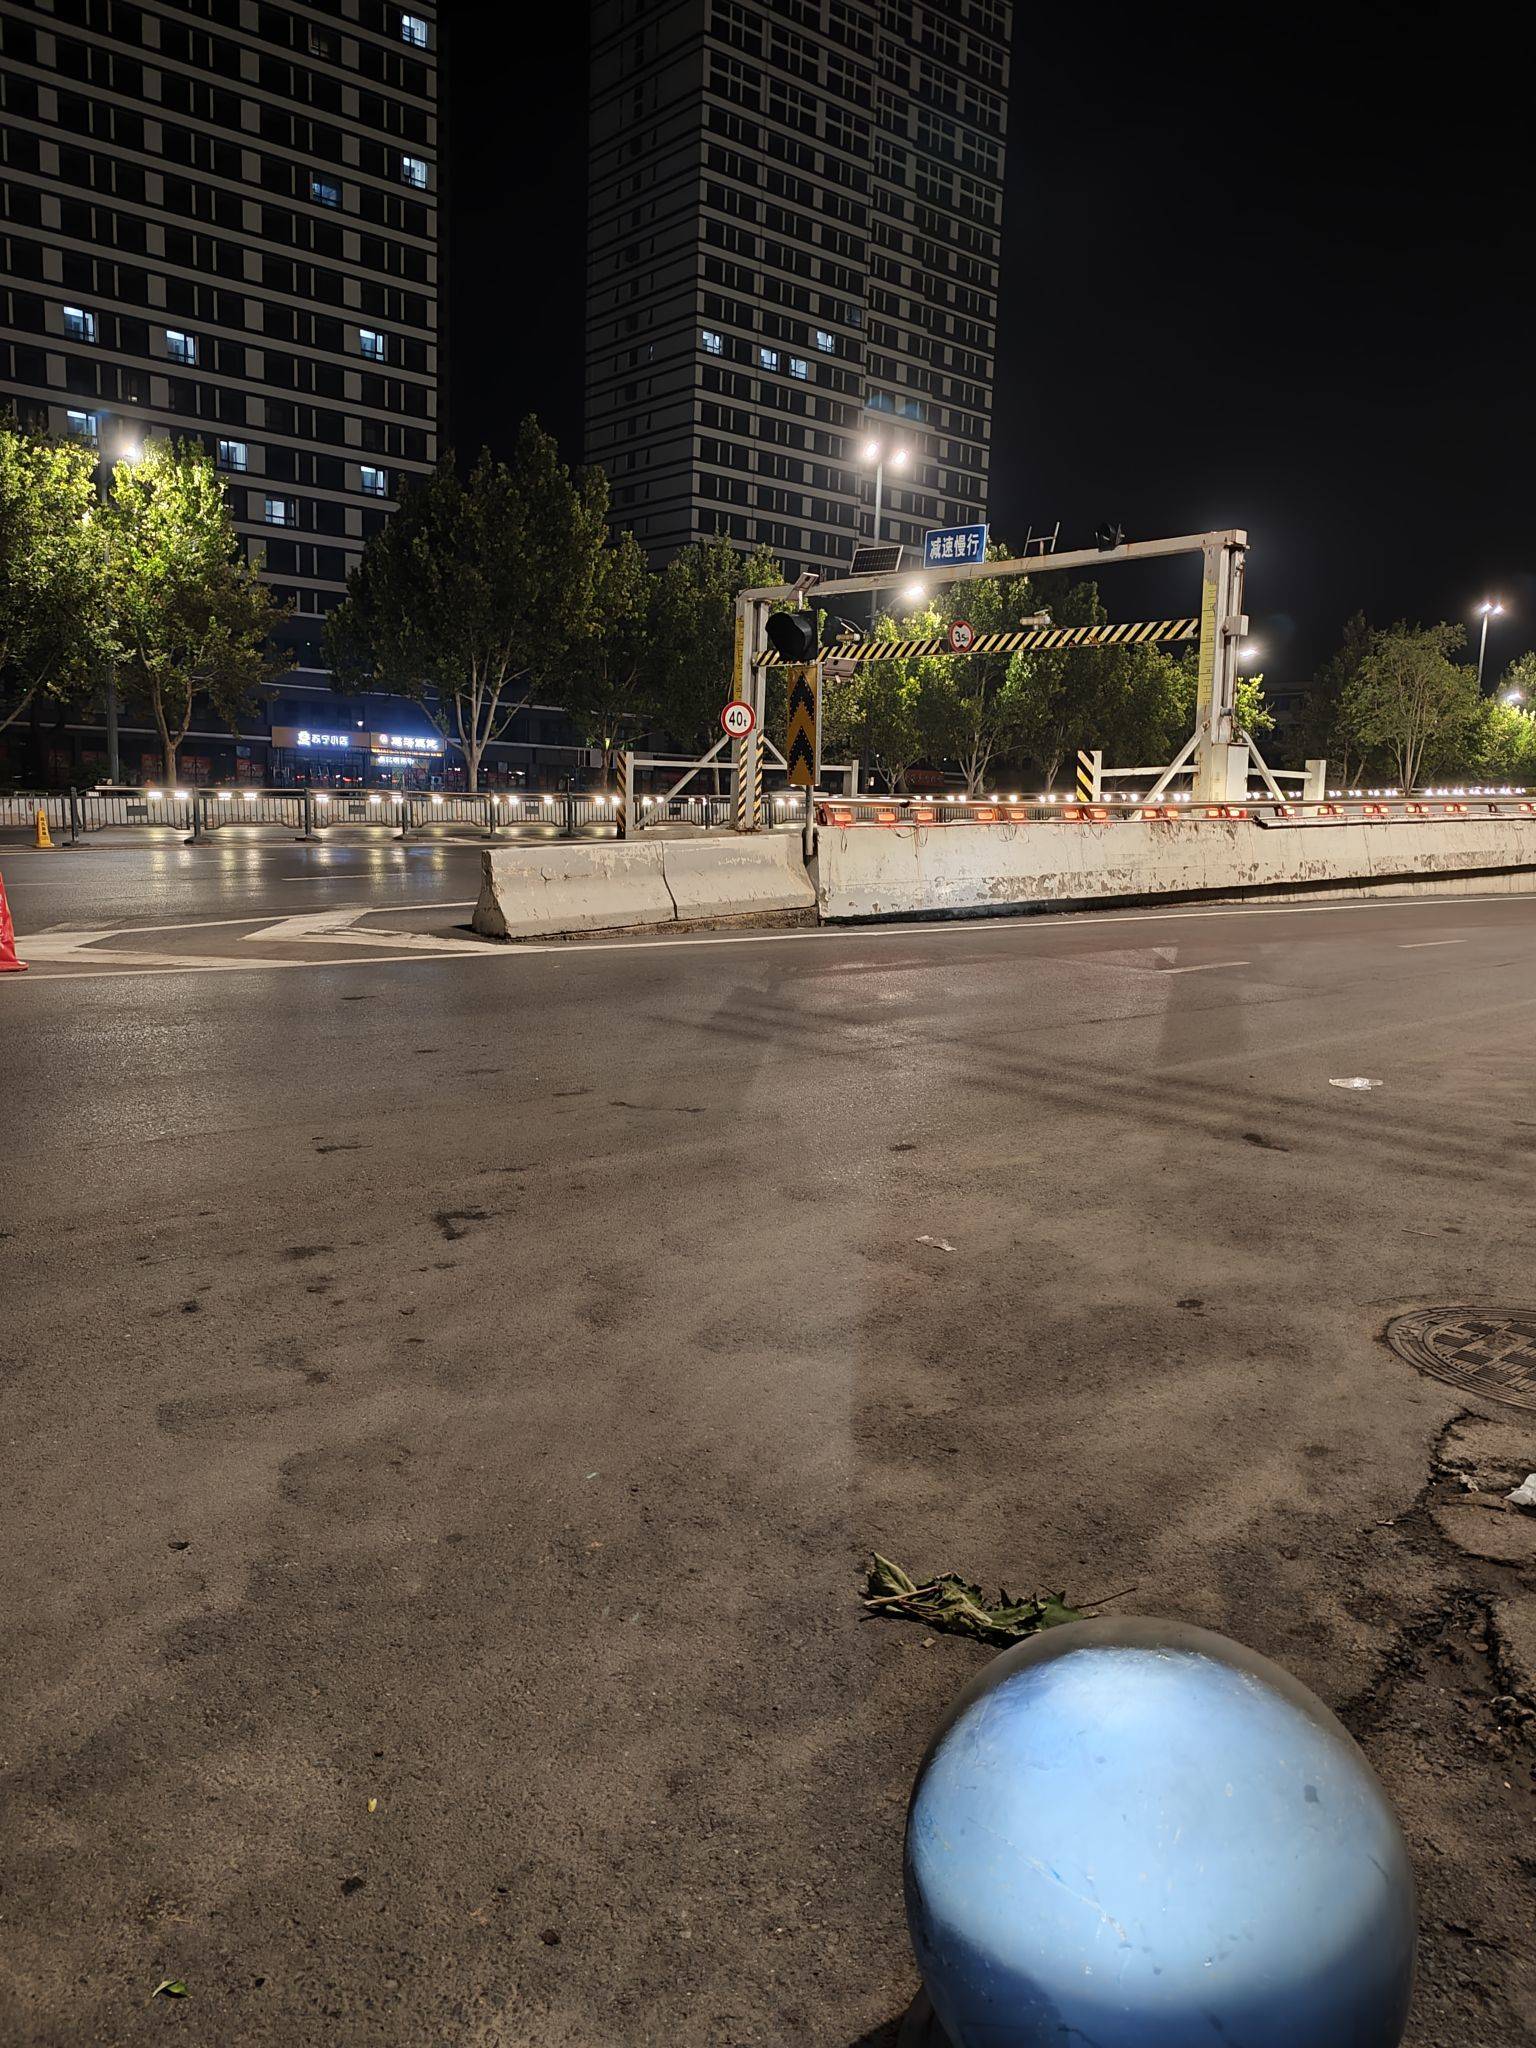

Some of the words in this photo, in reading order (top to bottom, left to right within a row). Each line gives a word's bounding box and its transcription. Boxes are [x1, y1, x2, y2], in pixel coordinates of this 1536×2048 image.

[930, 533, 979, 559] 减速慢行
[729, 711, 747, 727] 40t
[311, 734, 349, 746] 苏宁小店
